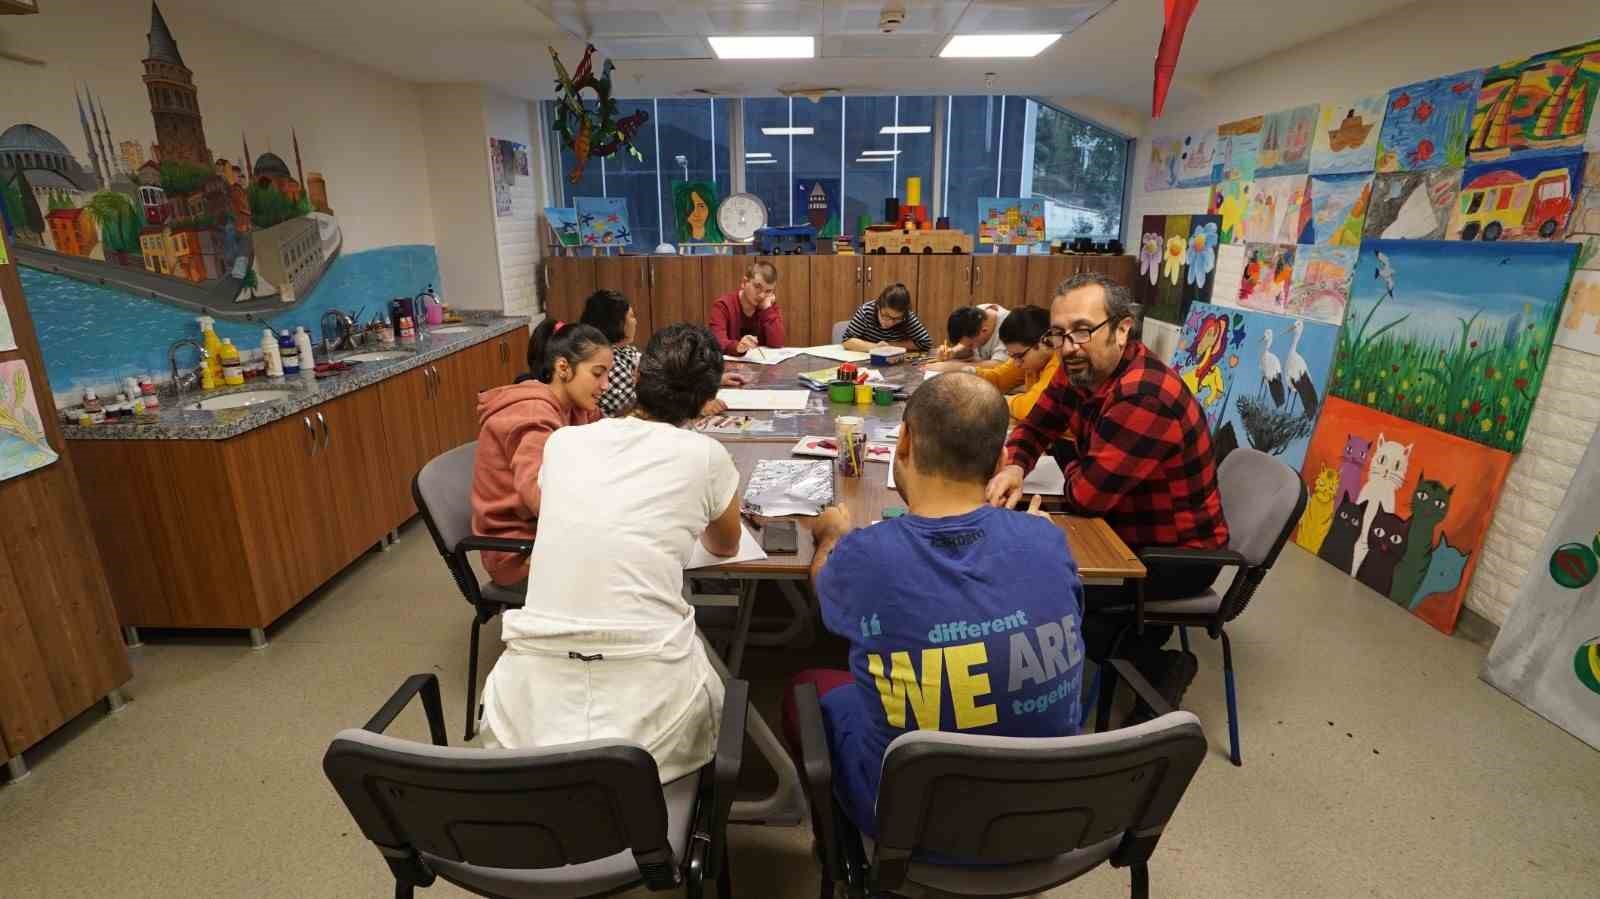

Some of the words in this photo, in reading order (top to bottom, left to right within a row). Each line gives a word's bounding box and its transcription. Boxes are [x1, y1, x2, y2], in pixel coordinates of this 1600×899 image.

[928, 608, 1029, 644] different
[867, 641, 999, 731] WE
[1007, 614, 1083, 692] ARE
[1011, 676, 1081, 716] togethe
